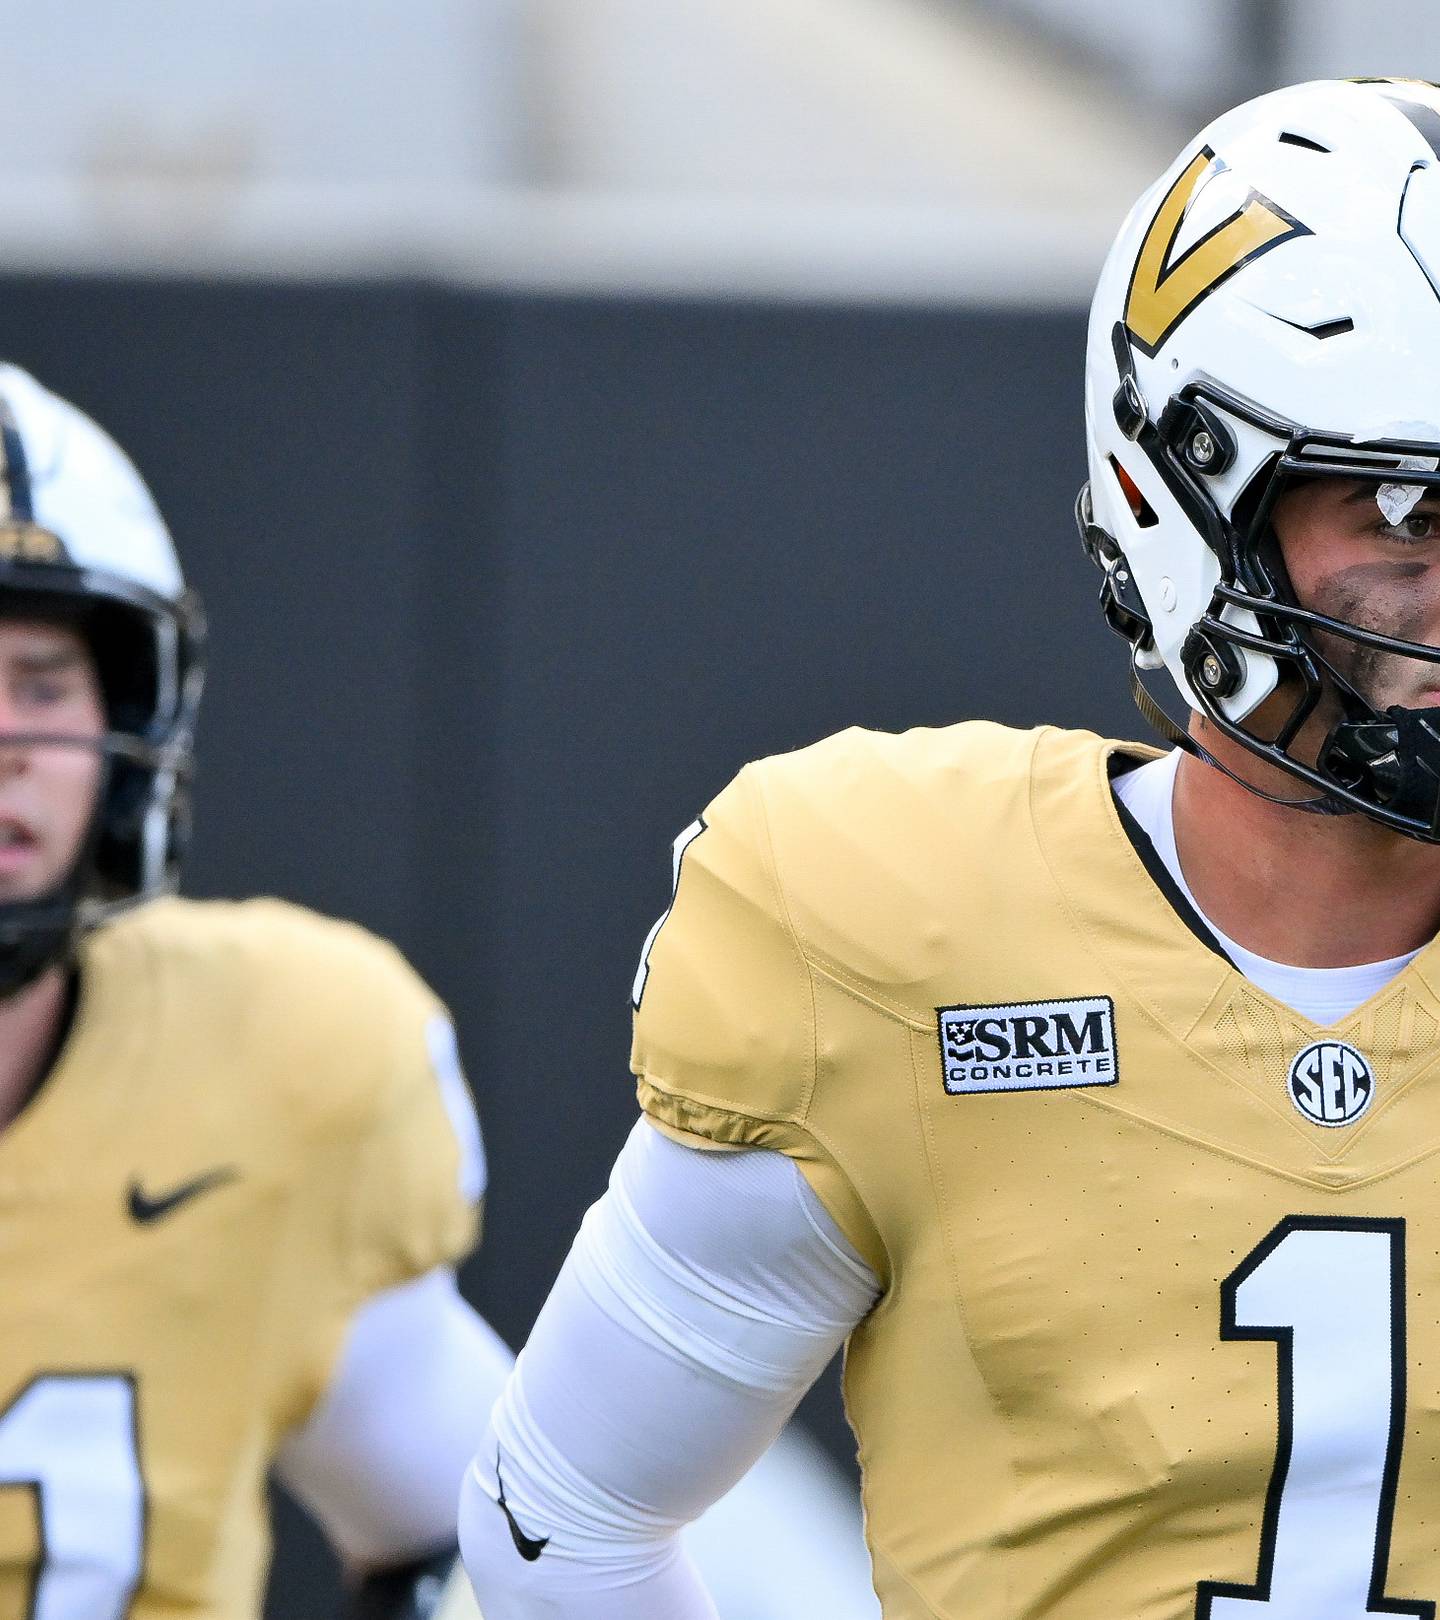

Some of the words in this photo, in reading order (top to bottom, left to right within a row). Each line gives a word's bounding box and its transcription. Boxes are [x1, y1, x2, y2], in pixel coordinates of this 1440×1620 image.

[1123, 143, 1317, 359] V
[949, 1057, 1112, 1082] CONCRETE
[974, 1010, 1110, 1063] SRM
[1295, 1046, 1367, 1120] SEC
[1195, 1214, 1437, 1620] 1
